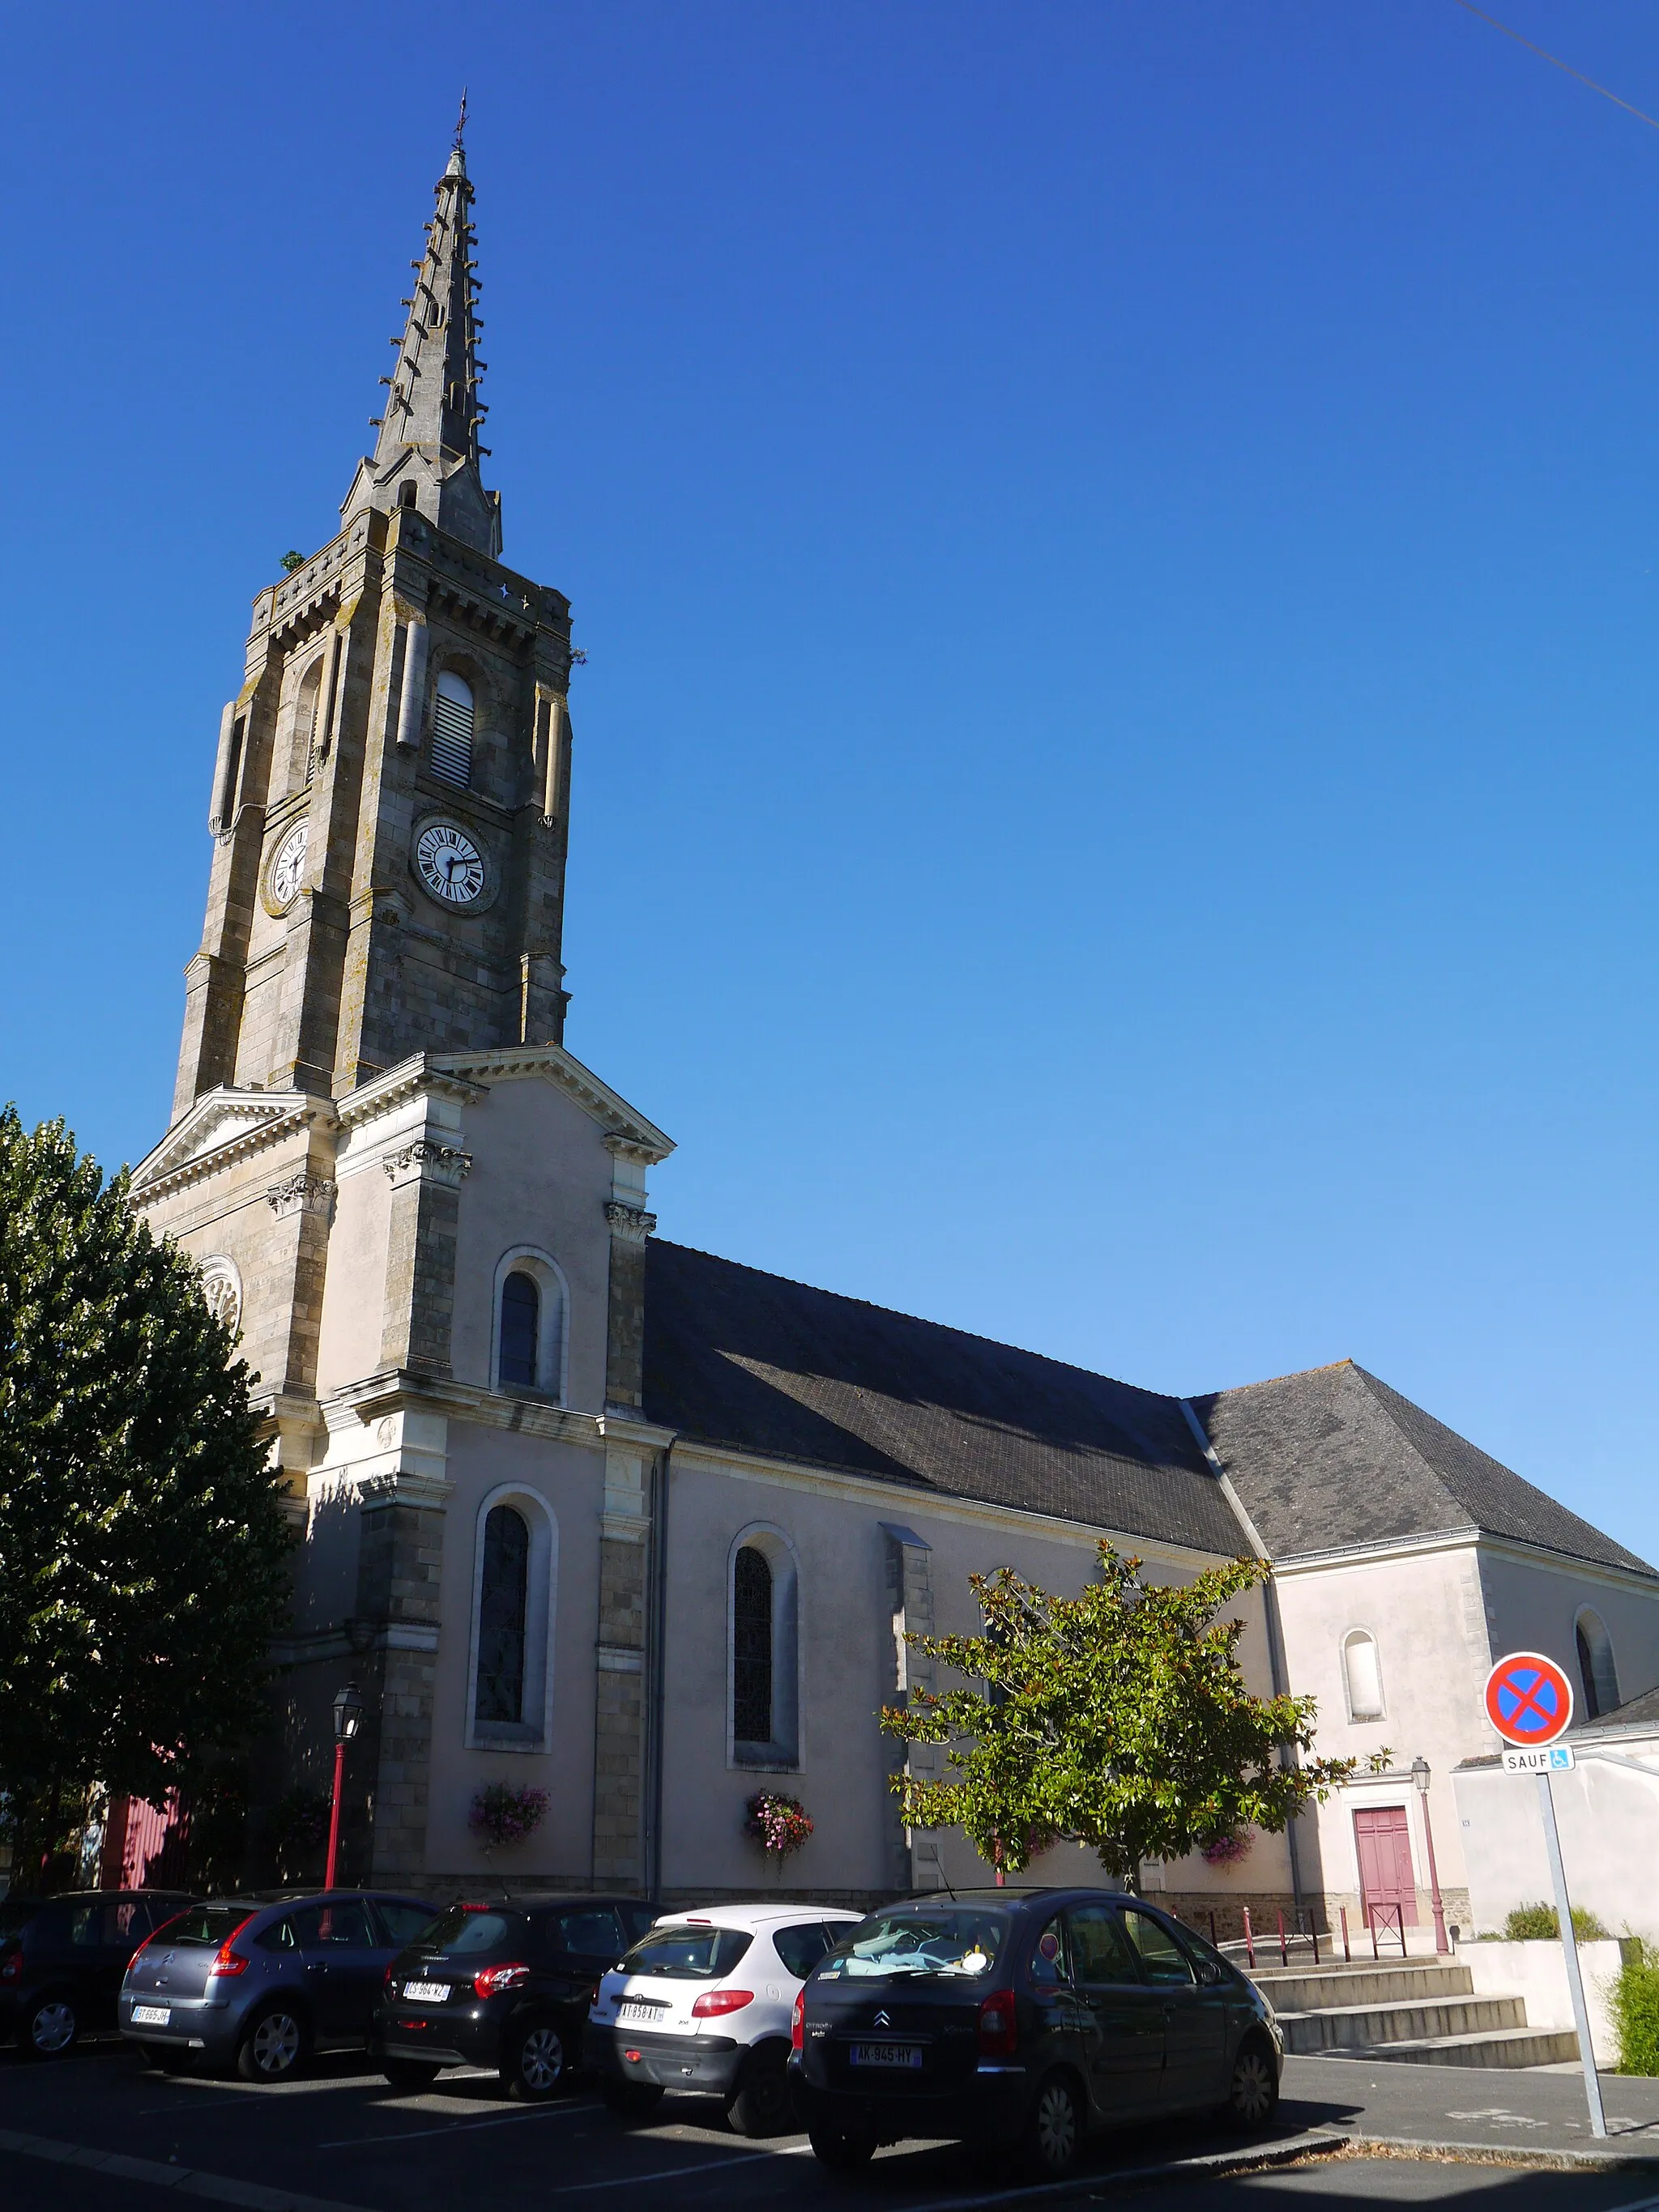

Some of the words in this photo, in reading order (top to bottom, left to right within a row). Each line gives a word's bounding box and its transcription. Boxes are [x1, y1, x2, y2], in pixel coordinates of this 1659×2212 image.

[1508, 1754, 1546, 1769] SAUF
[622, 2005, 659, 2021] AT-858-AT
[858, 2045, 912, 2063] AK-945-HY
